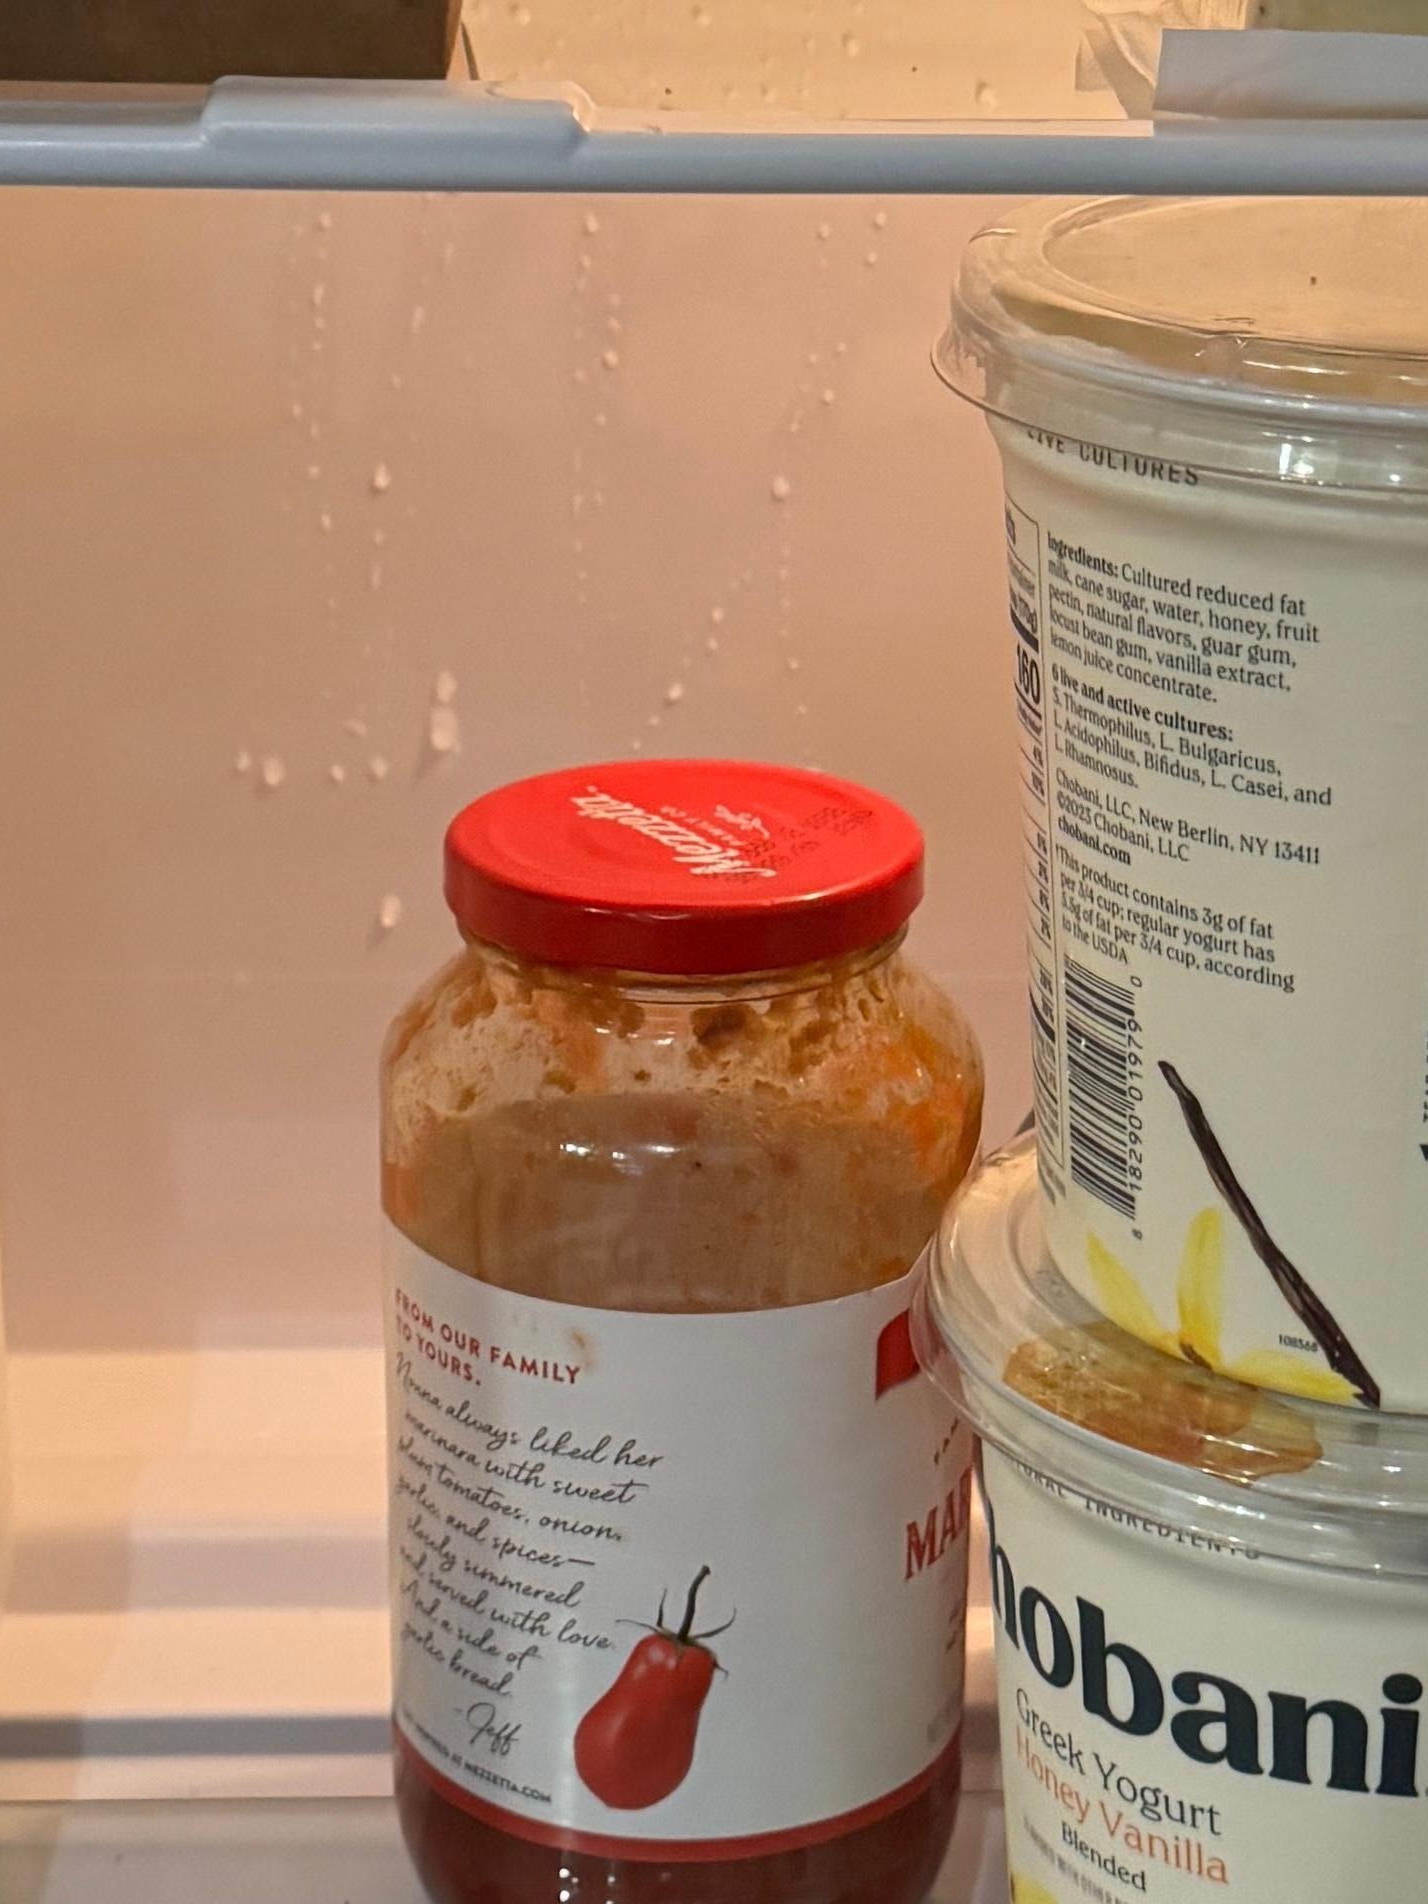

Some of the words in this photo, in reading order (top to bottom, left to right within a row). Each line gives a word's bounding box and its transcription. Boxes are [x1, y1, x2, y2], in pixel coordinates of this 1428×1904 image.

[1048, 531, 1120, 579] Ingredients:
[1121, 562, 1191, 598] Cultured
[1195, 584, 1274, 612] reduced
[1279, 594, 1306, 617] fat
[1153, 598, 1204, 627] water,
[1208, 608, 1271, 641] honey,
[1276, 623, 1320, 644] fruit
[1116, 662, 1217, 703] concentrate.
[1156, 650, 1212, 677] vanilla
[1216, 665, 1290, 691] extract,
[1065, 692, 1155, 748] Thermophilus,
[1179, 737, 1282, 776] Bulgaricus,
[1081, 683, 1104, 705] and
[1107, 696, 1151, 721] active
[1155, 711, 1233, 742] cultures:
[1056, 768, 1102, 809] Chobani,
[1106, 794, 1136, 823] LLC,
[1139, 808, 1173, 833] New
[1178, 819, 1234, 851] Berlin,
[1240, 835, 1268, 856] NY
[1274, 841, 1320, 865] 13411
[1058, 817, 1132, 866] chobani.com
[1204, 958, 1295, 993] according
[1128, 1018, 1143, 1101] 01979
[1128, 1113, 1143, 1193] 18290
[395, 1288, 434, 1333] FROM
[440, 1324, 480, 1357] OUR
[490, 1346, 580, 1385] FAMILY
[396, 1317, 412, 1343] TO
[417, 1333, 481, 1386] YOURS.
[445, 1400, 517, 1450] always
[531, 1427, 608, 1464] liked
[614, 1440, 665, 1469] her
[485, 1460, 545, 1488] with
[553, 1480, 650, 1503] sweet
[446, 1513, 488, 1543] and
[464, 1559, 585, 1608] simmered
[491, 1609, 551, 1638] with
[557, 1615, 612, 1649] love
[1015, 1686, 1086, 1777] Greek
[1093, 1753, 1223, 1836] Yogurt
[1015, 1727, 1093, 1823] Honey
[1100, 1800, 1230, 1887] Vanilla
[1061, 1821, 1147, 1892] Blended
